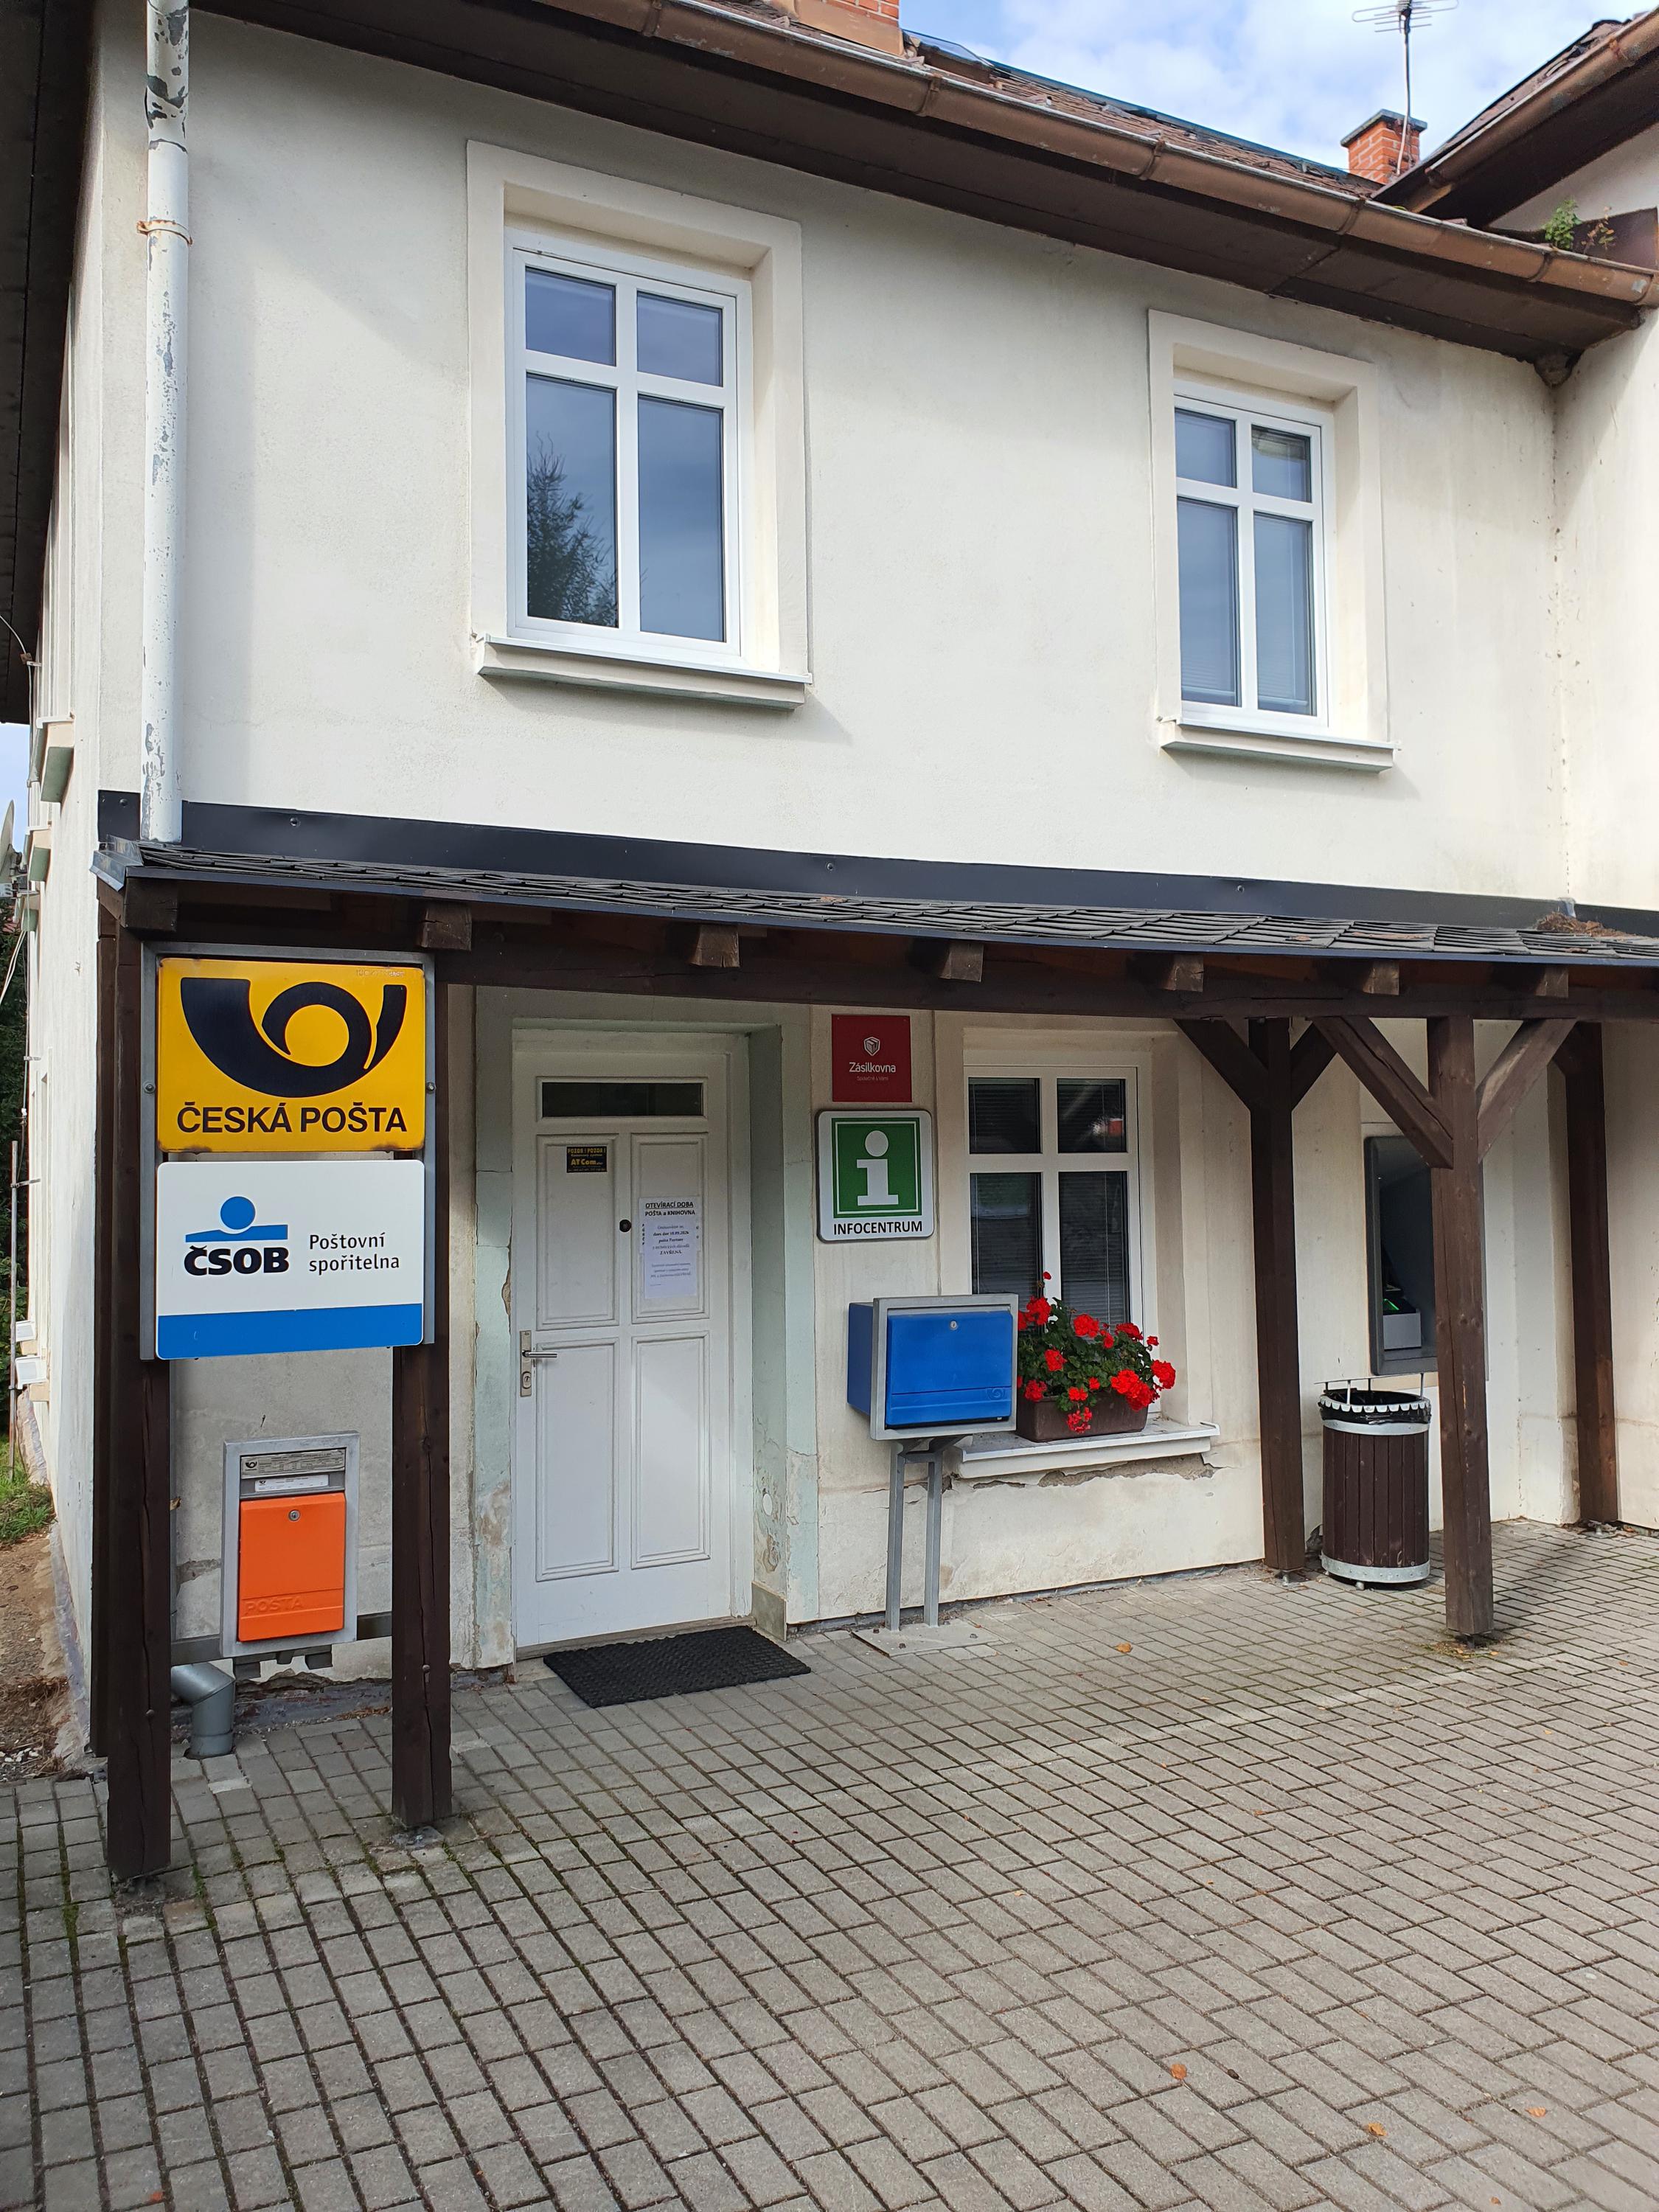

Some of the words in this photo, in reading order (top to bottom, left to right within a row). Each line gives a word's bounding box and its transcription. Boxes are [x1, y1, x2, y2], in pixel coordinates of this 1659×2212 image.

[849, 1062, 896, 1073] Zásilkovna
[177, 1101, 293, 1133] ČESKÁ
[301, 1101, 408, 1133] POŠTA
[645, 1200, 676, 1209] OTEVÍRACÍ
[834, 1221, 922, 1235] INFOCENTRUM
[310, 1232, 386, 1250] Poštovní
[184, 1245, 290, 1276] ČSOB
[309, 1254, 400, 1276] spořitelna
